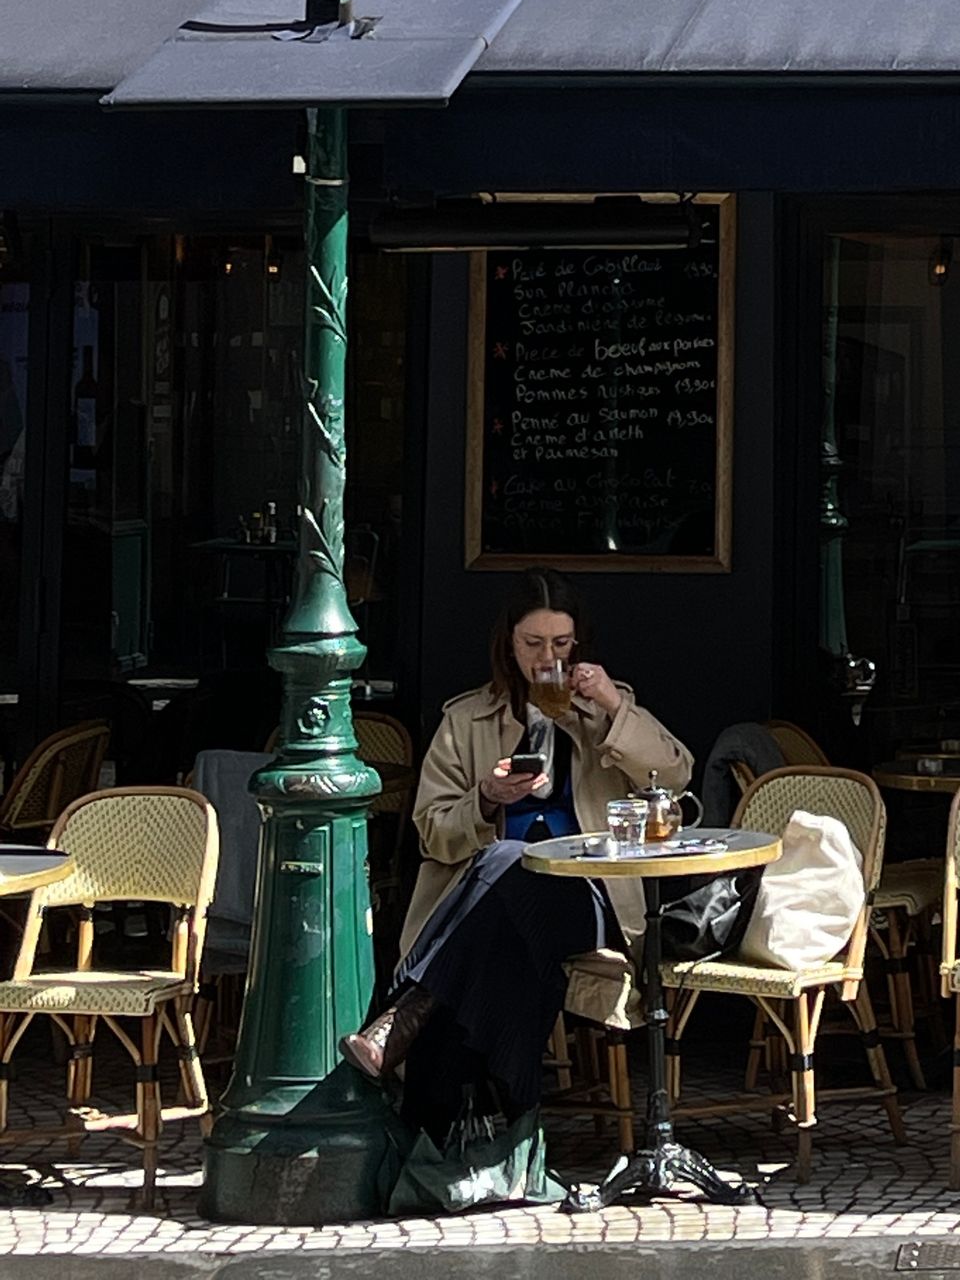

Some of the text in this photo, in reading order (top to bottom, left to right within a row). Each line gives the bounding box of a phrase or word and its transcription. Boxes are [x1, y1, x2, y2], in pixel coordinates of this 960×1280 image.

[555, 260, 577, 277] de
[515, 384, 589, 403] Pommes
[566, 412, 591, 426] au
